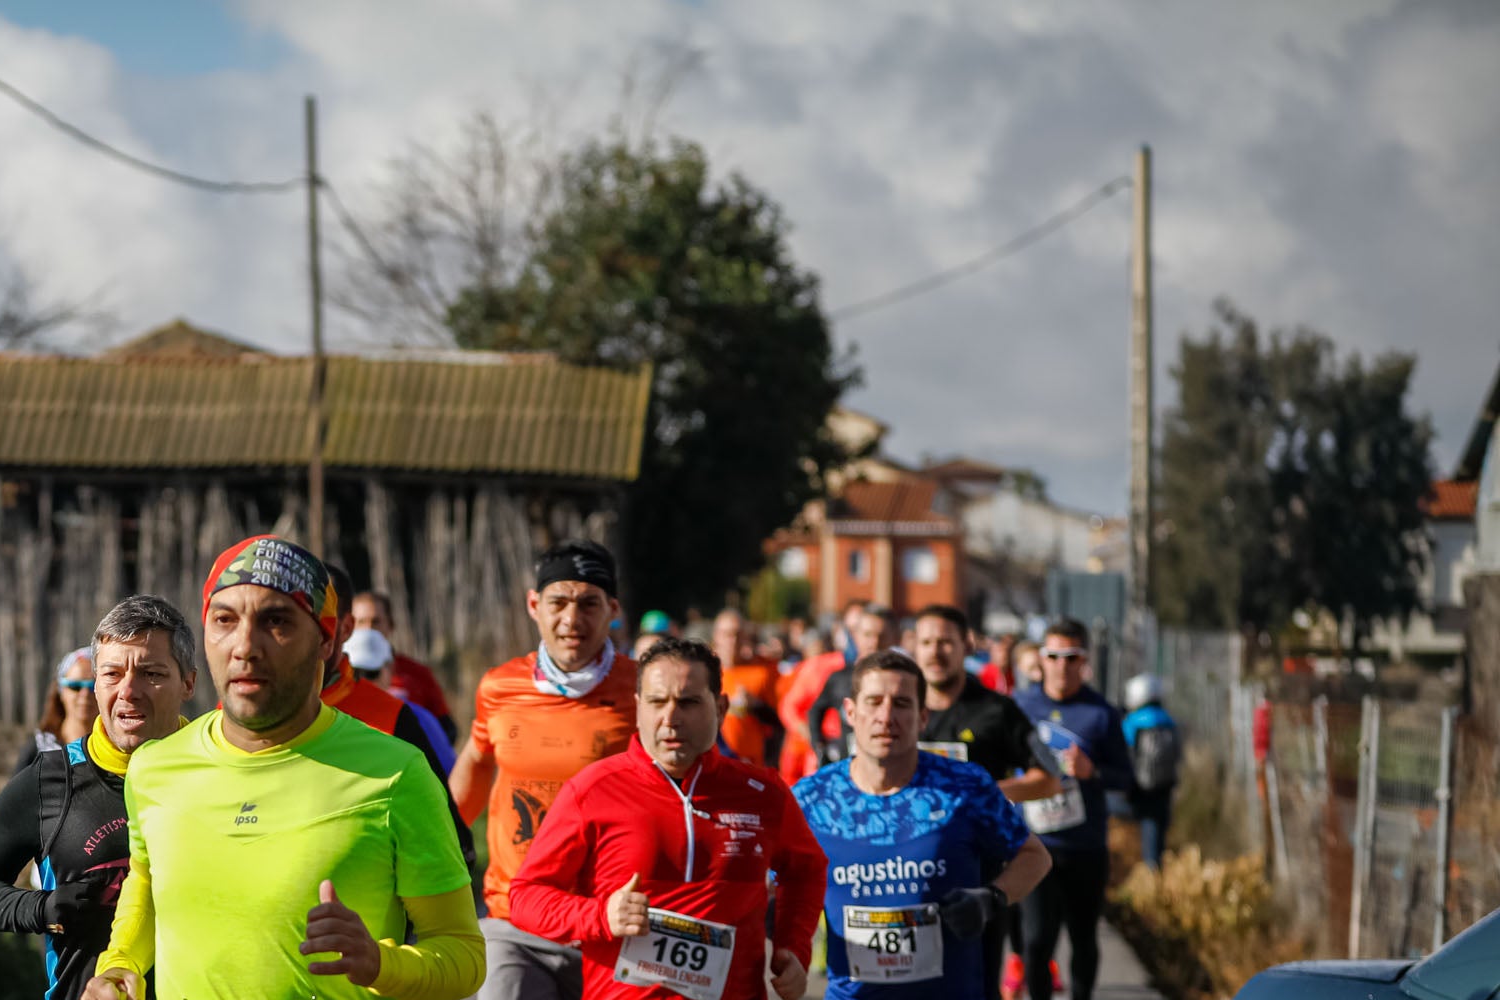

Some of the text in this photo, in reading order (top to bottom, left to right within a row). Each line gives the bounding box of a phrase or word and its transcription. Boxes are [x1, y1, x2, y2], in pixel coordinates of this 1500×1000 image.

[833, 855, 947, 890] agustinos
[850, 882, 930, 899] GRANADA
[652, 936, 708, 971] 169
[867, 929, 916, 955] 481
